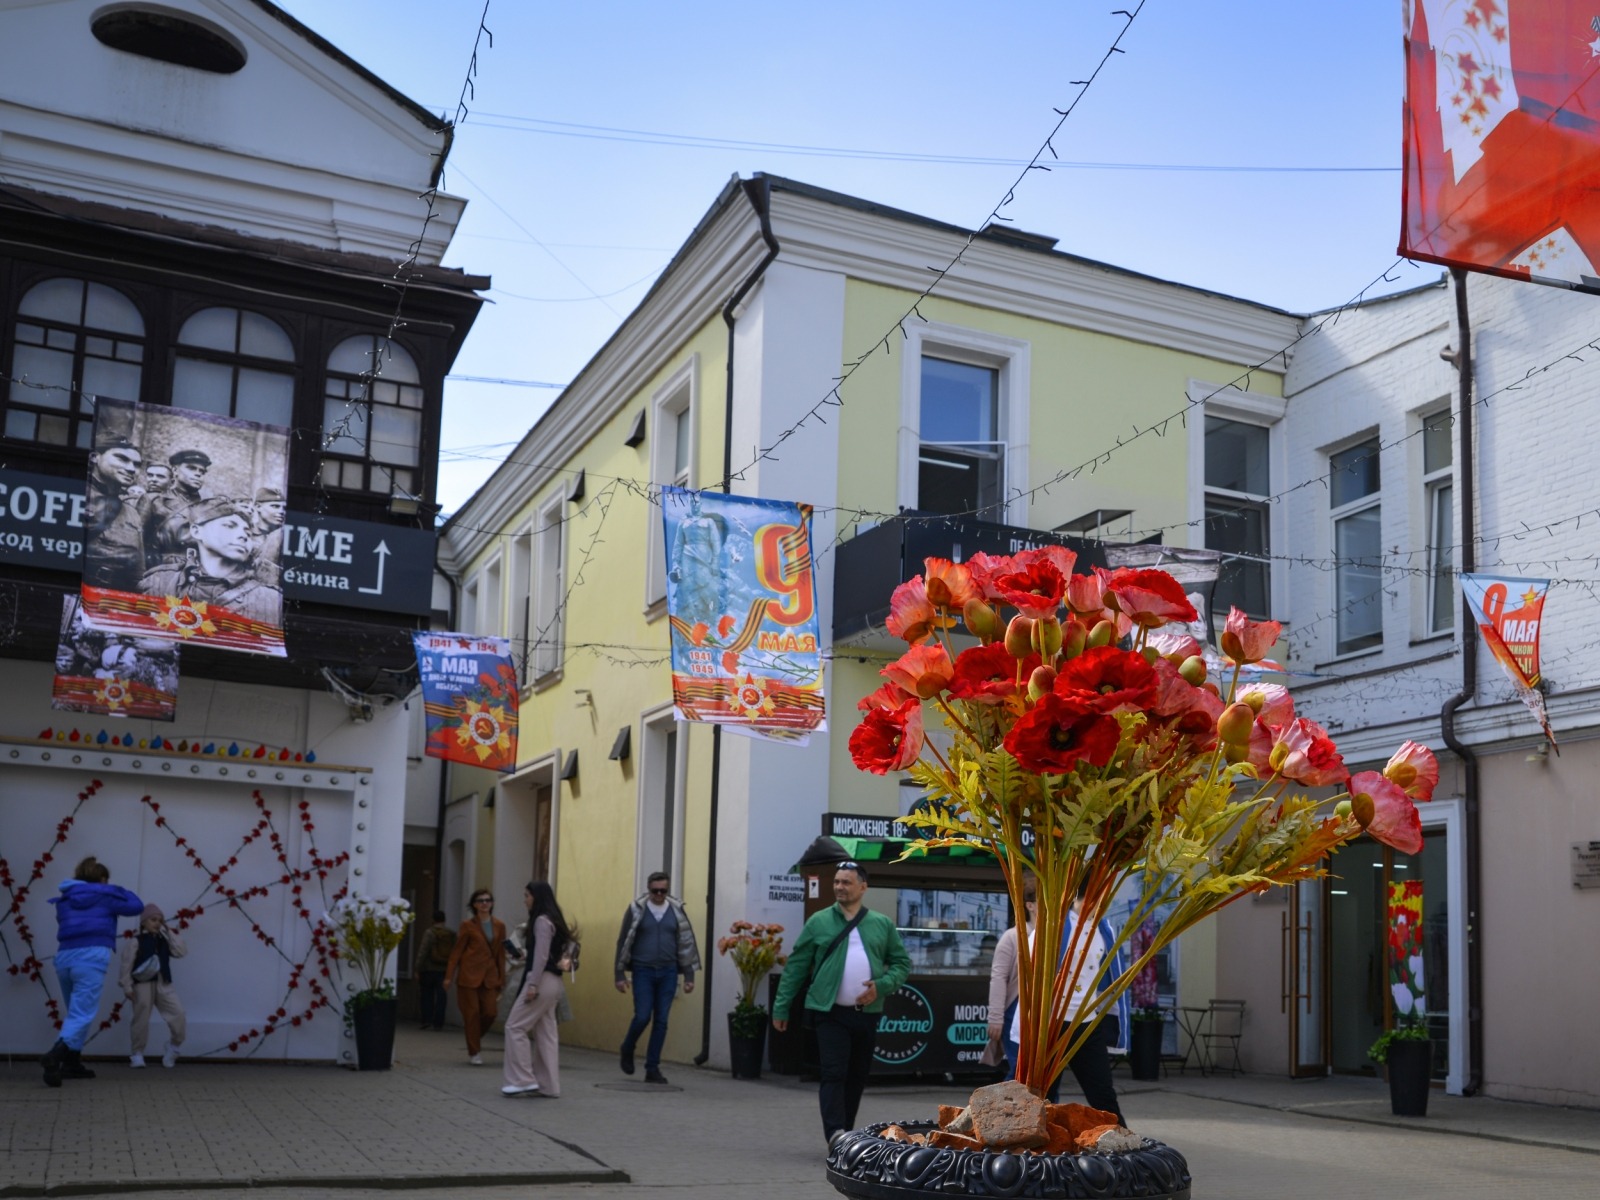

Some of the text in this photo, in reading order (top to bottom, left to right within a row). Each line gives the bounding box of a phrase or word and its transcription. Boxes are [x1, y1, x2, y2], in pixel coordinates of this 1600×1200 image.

[0, 482, 86, 528] OFF
[754, 523, 814, 626] 9
[1503, 619, 1539, 642] МАЯ
[430, 639, 451, 648] 1941
[759, 631, 816, 653] МАЯ
[690, 651, 712, 661] 1941
[442, 658, 478, 675] МАЯ
[691, 664, 714, 674] 1945
[833, 816, 909, 838] МОРОЖЕНОЕ 18+
[892, 988, 923, 1006] REAM
